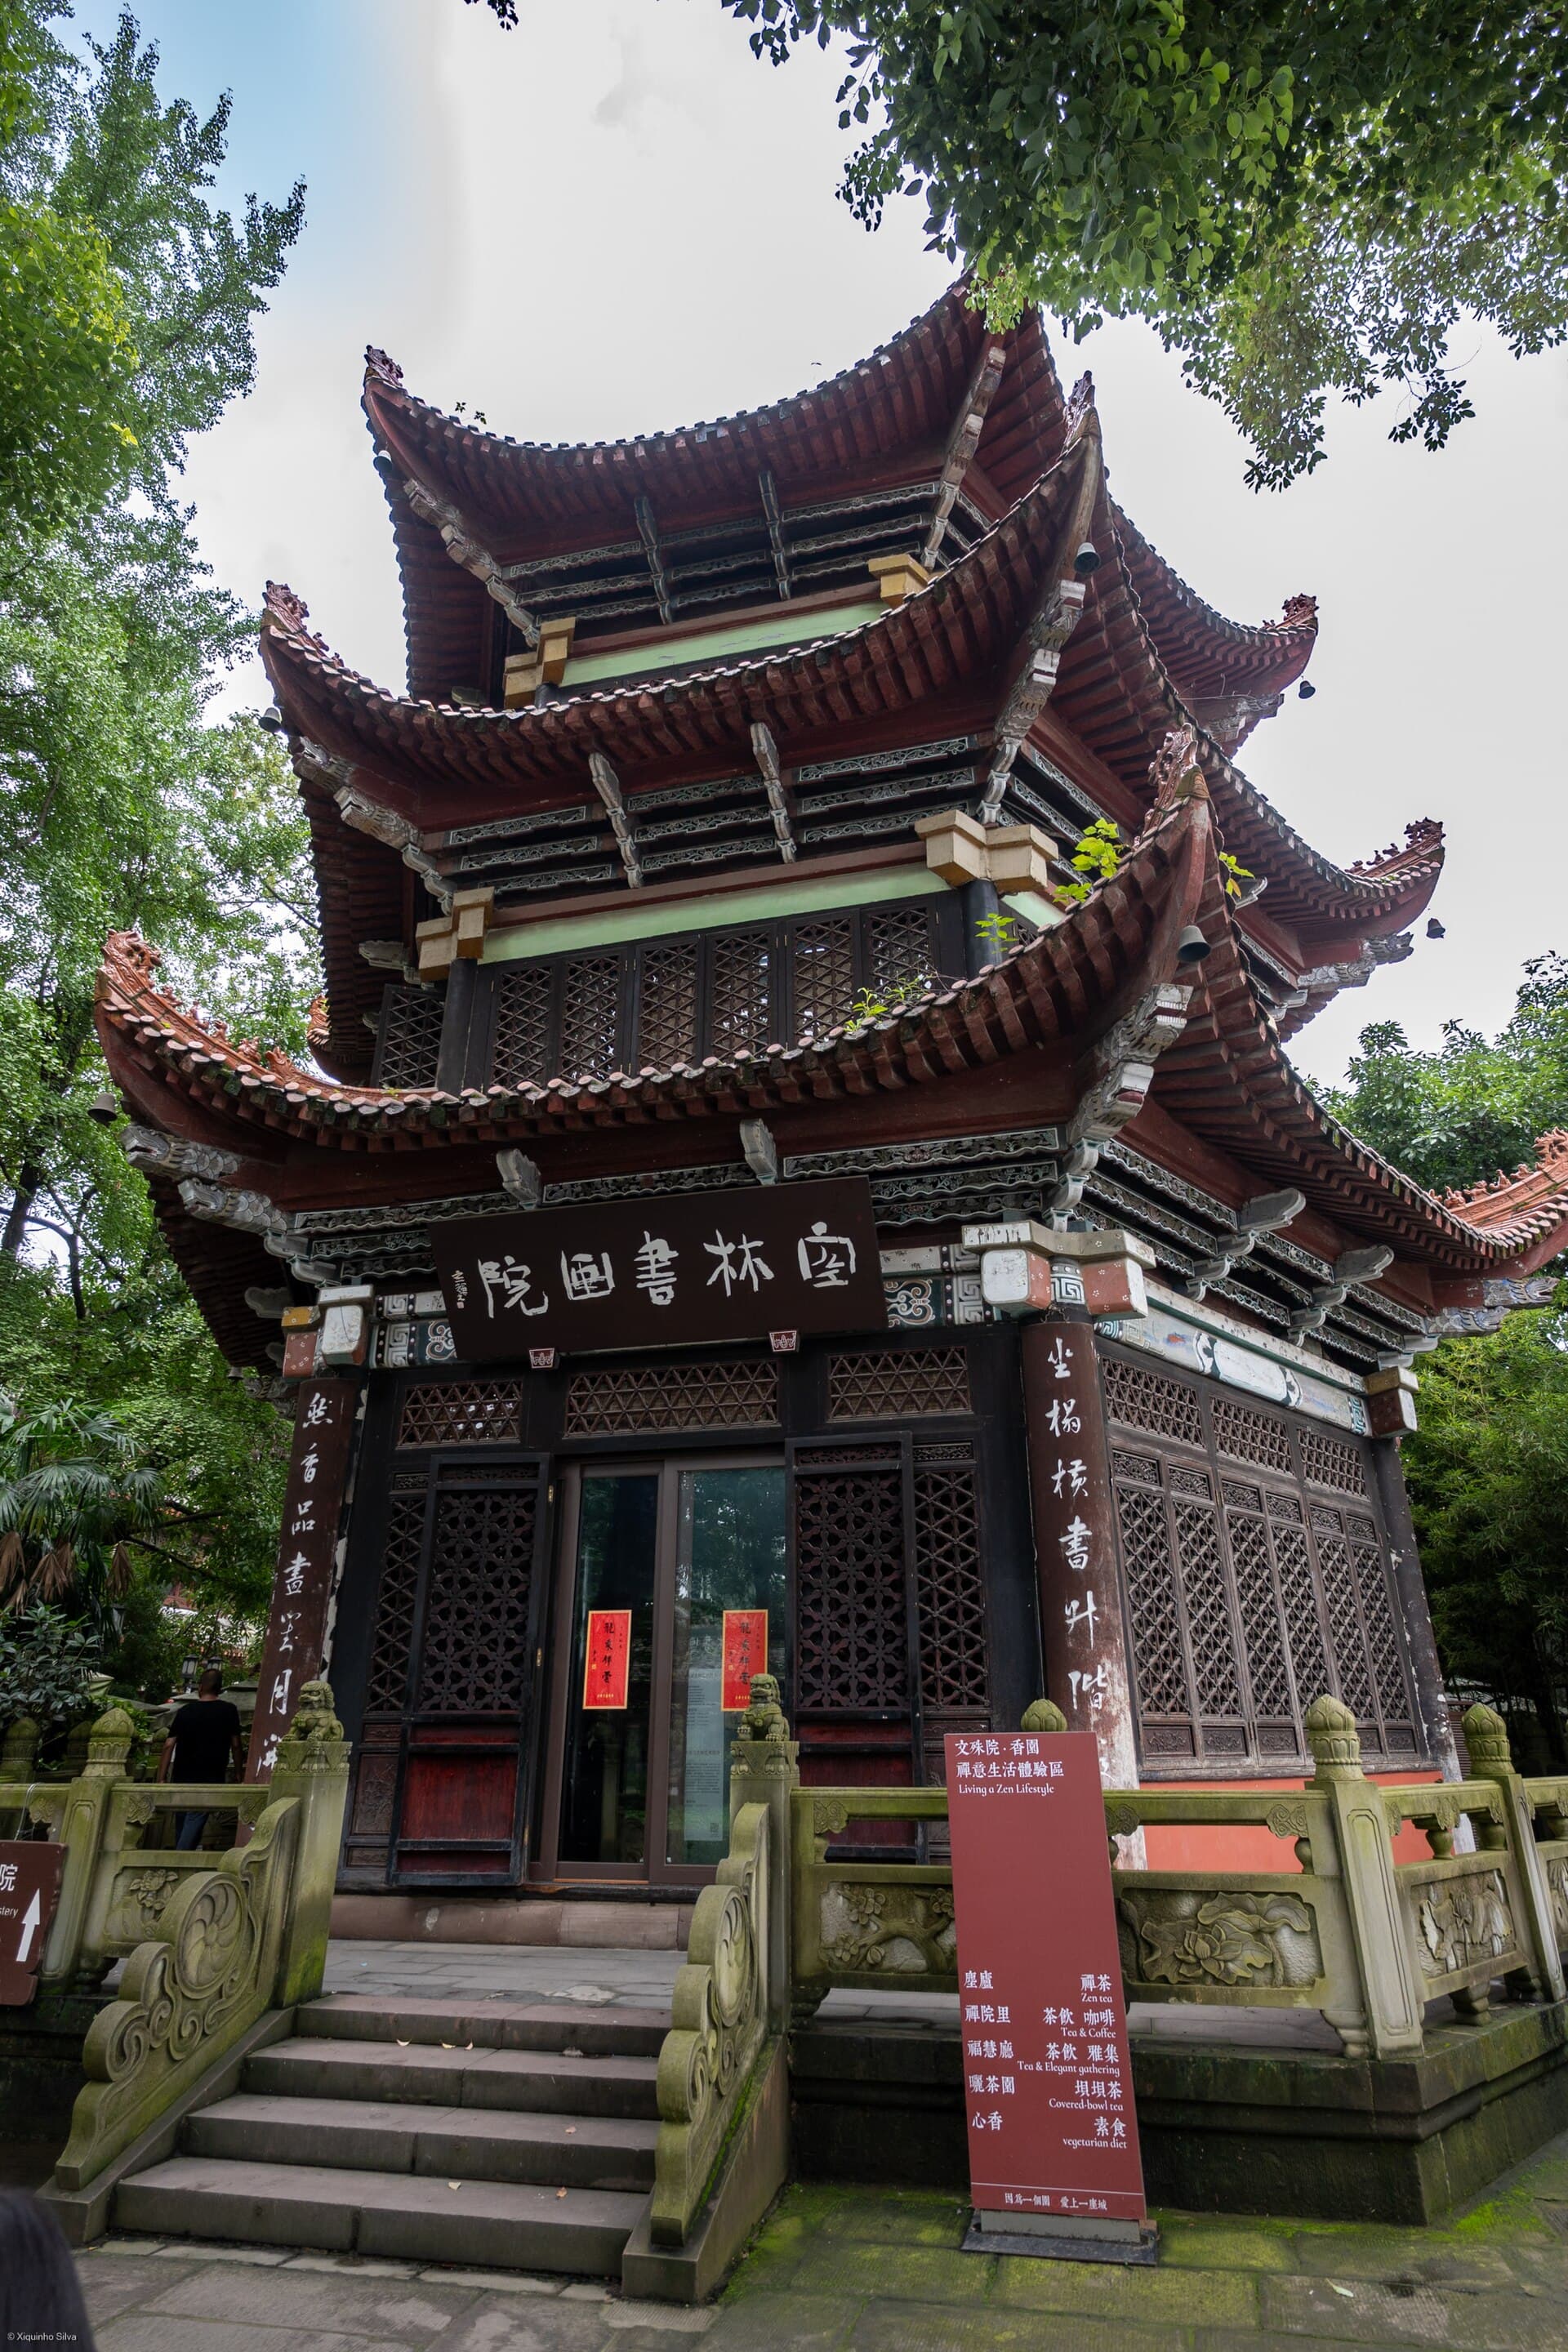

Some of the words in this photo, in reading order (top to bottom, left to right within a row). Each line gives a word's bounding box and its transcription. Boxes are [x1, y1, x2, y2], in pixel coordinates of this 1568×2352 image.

[957, 1761, 1064, 1779] 禪意生活體驗區
[959, 1784, 987, 1797] Living
[996, 1784, 1014, 1793] Zen
[1016, 1784, 1054, 1796] Lifestyle
[1080, 1973, 1111, 1992] 禪茶
[1080, 1993, 1098, 2002] Zen
[1099, 1995, 1113, 2003] tea
[965, 2005, 1011, 2024] 禪院里
[1043, 2007, 1074, 2026] 茶飲
[1083, 2008, 1116, 2027] 咖啡
[1060, 2027, 1078, 2038] Tea
[1080, 2028, 1087, 2038] &
[1088, 2028, 1116, 2039] Coffee
[1045, 2042, 1078, 2061] 茶飲
[1087, 2043, 1120, 2064] 雅集
[1018, 2060, 1034, 2071] Tea
[1036, 2061, 1044, 2071] &
[1045, 2061, 1077, 2075] Elegant
[1078, 2063, 1120, 2078] gathering
[1049, 2097, 1108, 2110] Covered-bowl
[1109, 2103, 1124, 2112] tea
[972, 2110, 1004, 2131] 心香
[1094, 2117, 1127, 2137] 素食
[1062, 2138, 1108, 2149] vegetarian
[1110, 2138, 1127, 2149] diet
